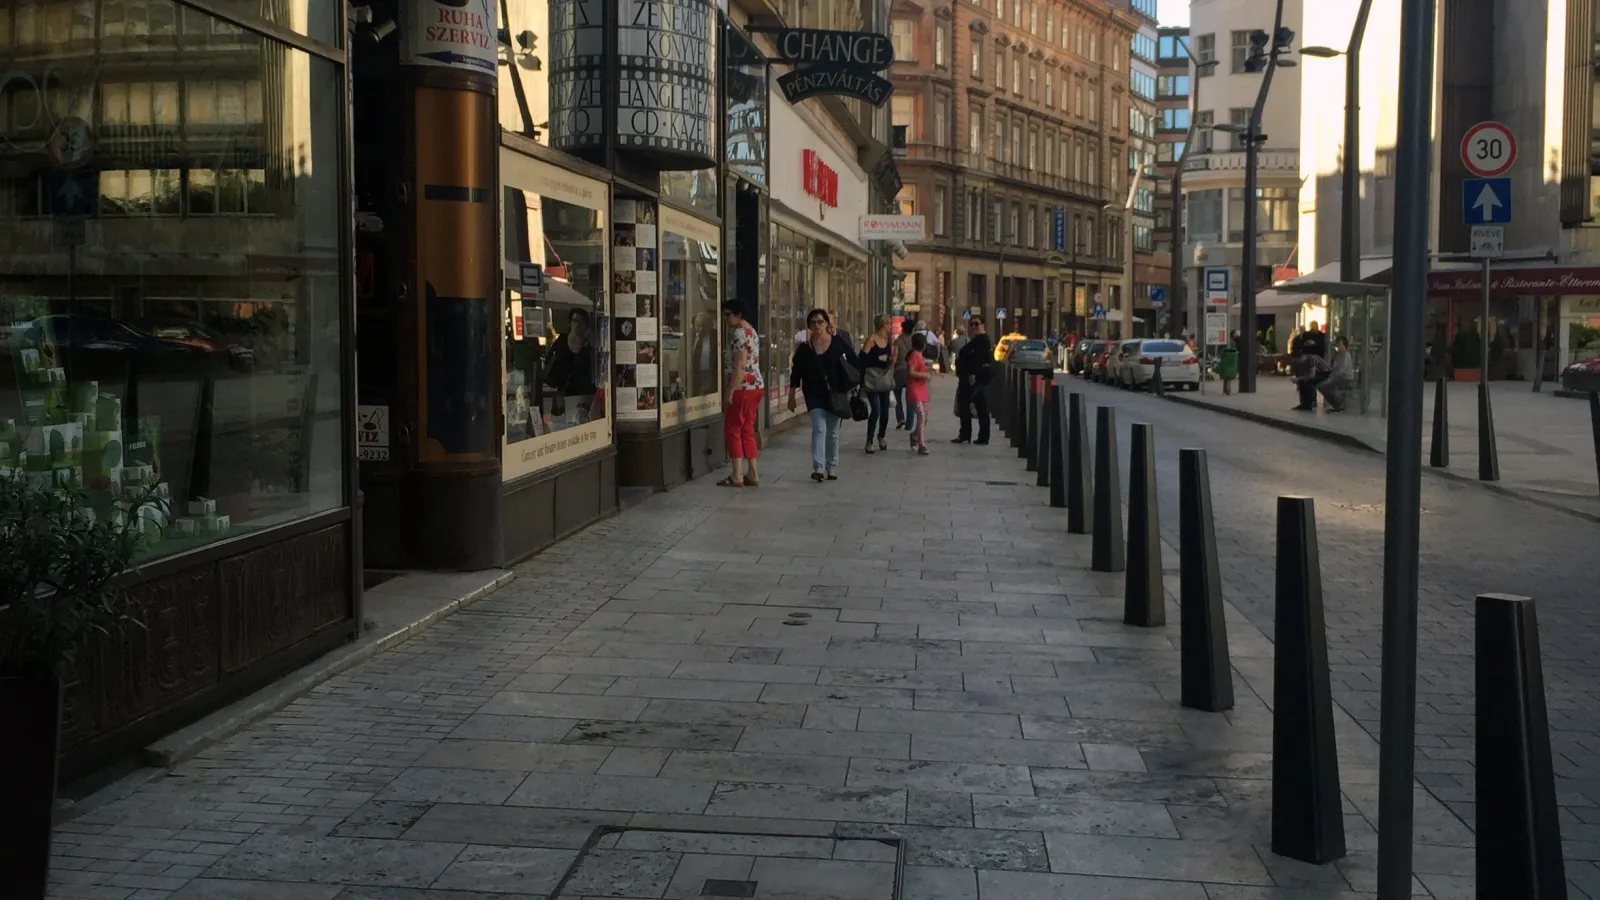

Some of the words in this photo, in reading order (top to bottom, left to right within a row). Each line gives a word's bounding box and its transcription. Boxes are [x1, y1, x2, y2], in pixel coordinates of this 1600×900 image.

[438, 8, 483, 29] RUHA
[426, 26, 490, 49] SZERVIZ
[784, 31, 885, 64] CHANGE
[786, 68, 883, 102] PÉNZVÁLTÁS
[631, 109, 659, 136] CD
[1476, 138, 1503, 160] 30
[864, 220, 921, 229] ROSSMANN
